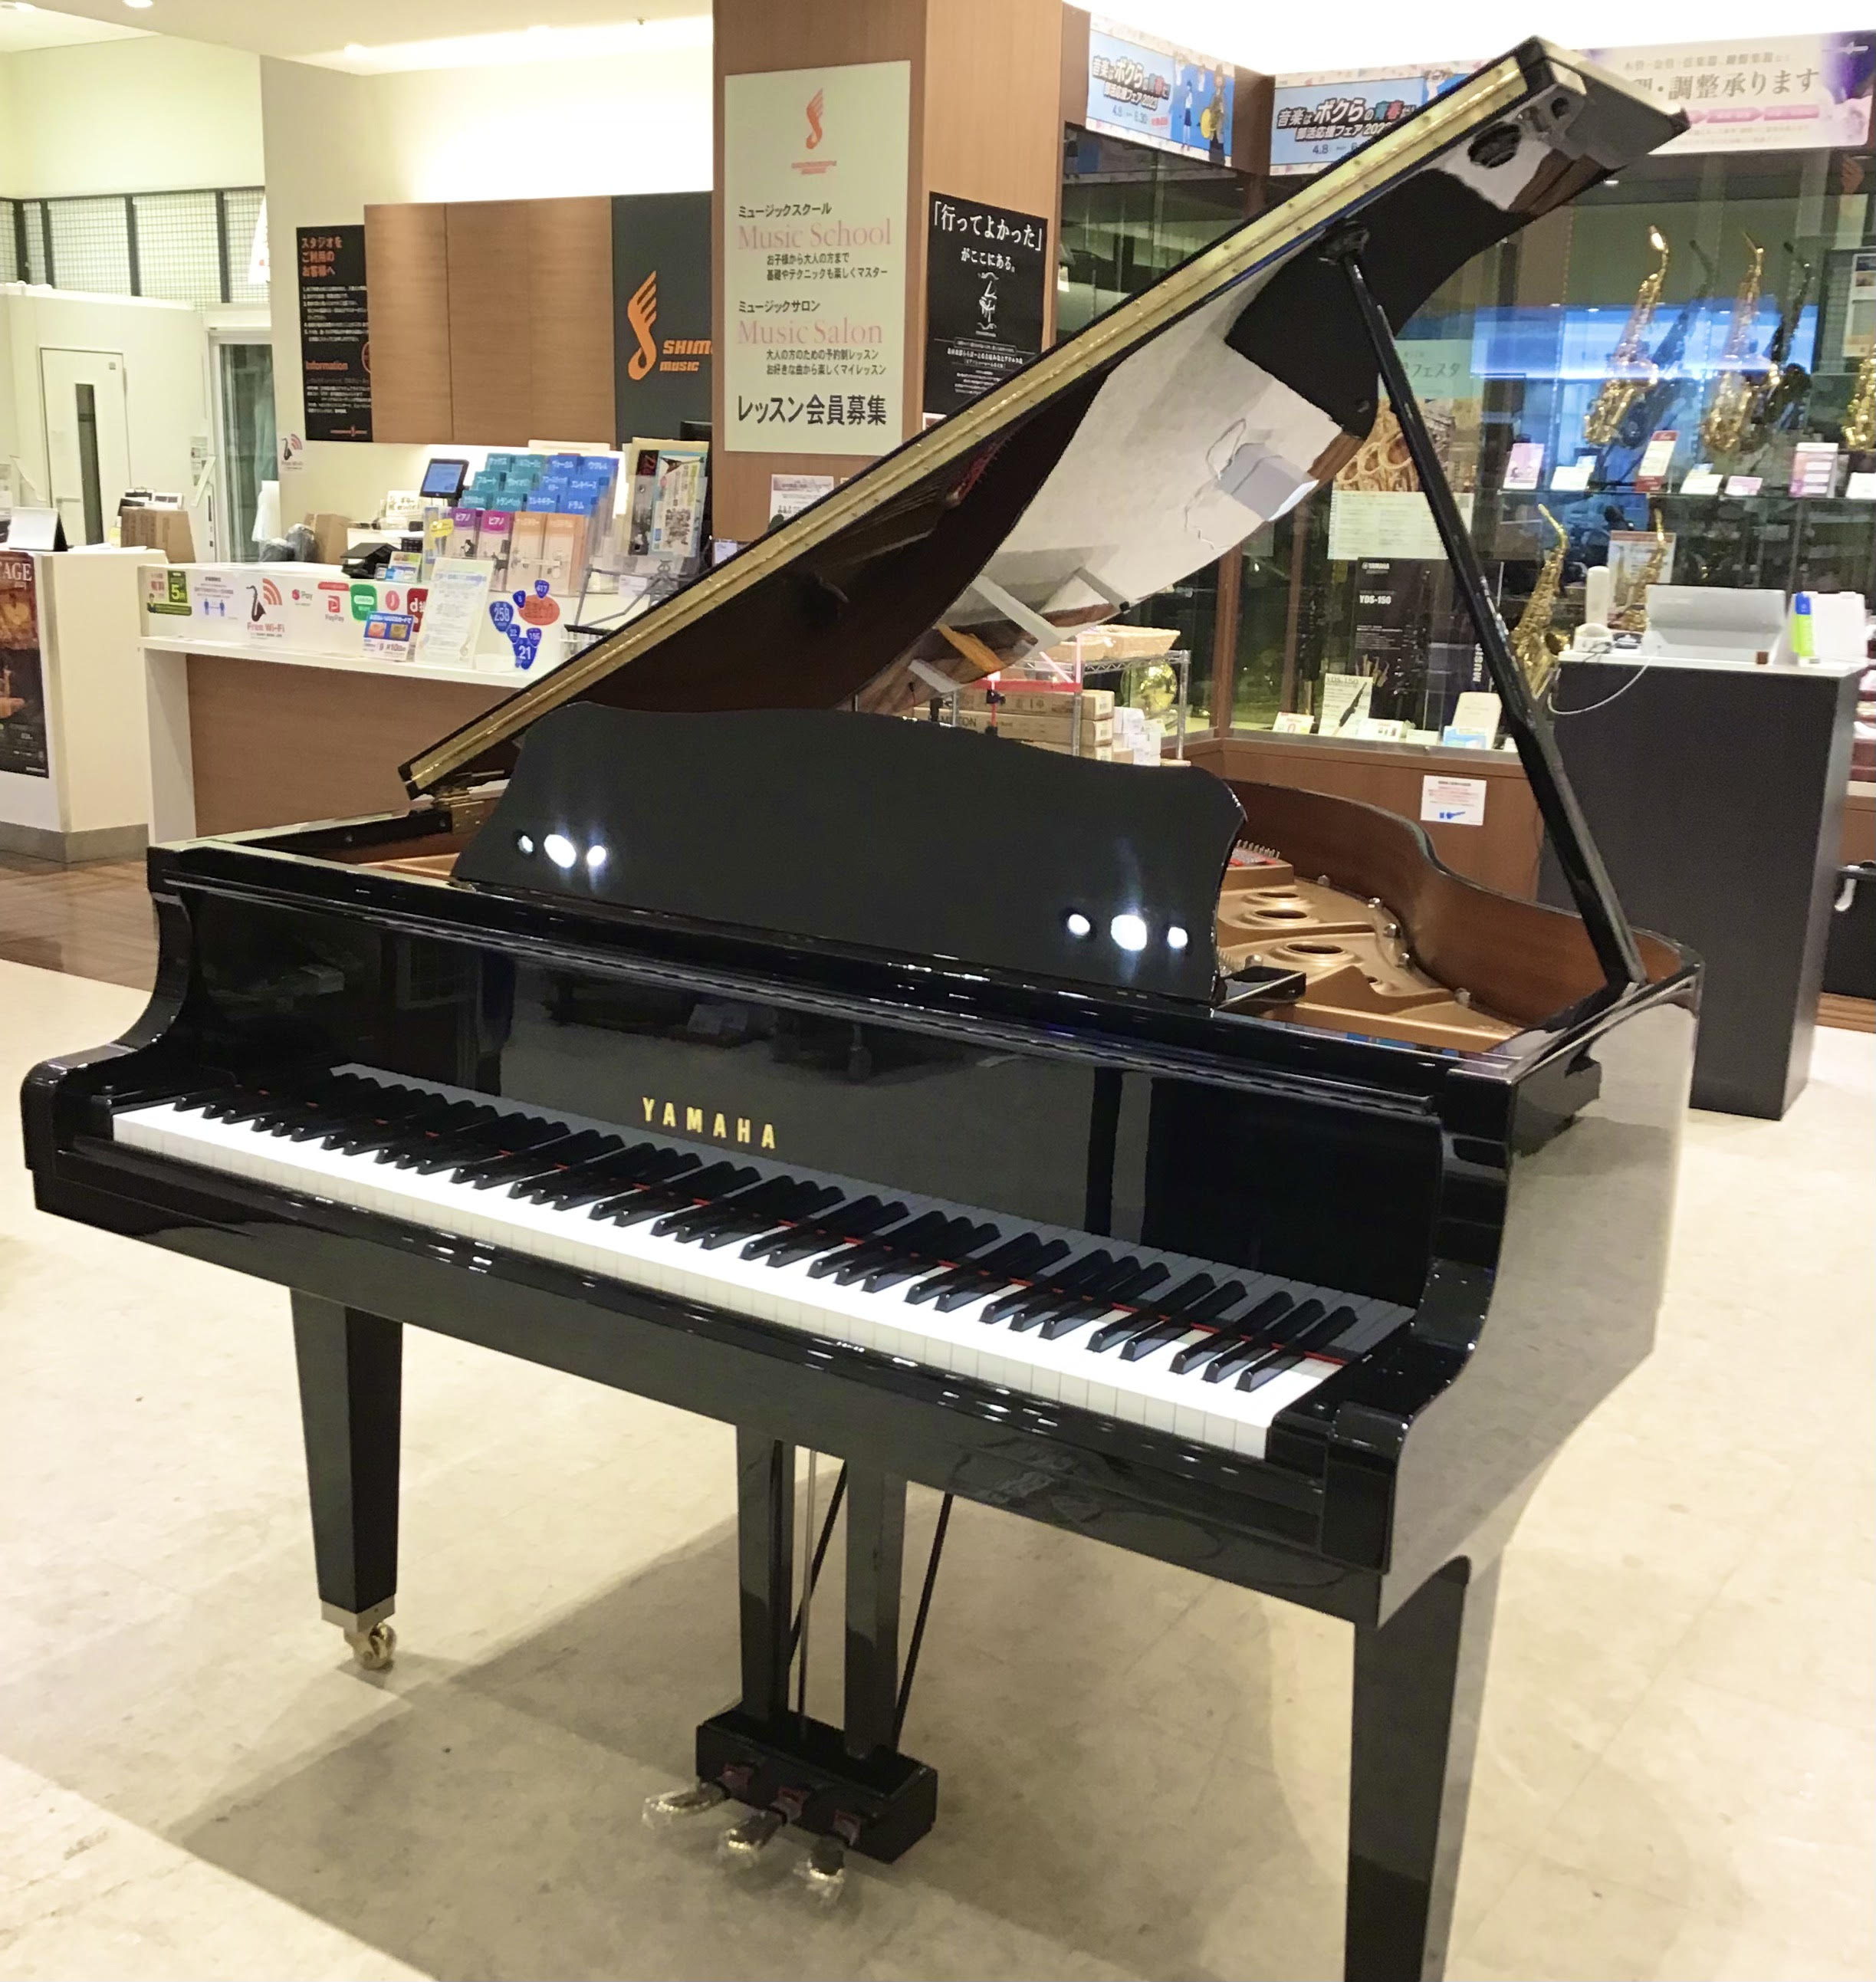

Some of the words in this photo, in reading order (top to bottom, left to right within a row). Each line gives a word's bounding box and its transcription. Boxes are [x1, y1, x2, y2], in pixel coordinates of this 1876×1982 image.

[738, 202, 833, 219] ミュージックスクール
[935, 201, 1043, 251] 「行ってよかった」
[738, 224, 804, 251] Music
[809, 218, 892, 248] School
[767, 252, 850, 266] お子様から大人の方まで
[961, 247, 1016, 273] がここにある。
[767, 267, 888, 281] 基礎やテクニックも楽しくマスター
[738, 300, 820, 313] ミュージックサロン
[738, 319, 809, 344] Music
[813, 317, 883, 345] Salon
[767, 363, 886, 376] お好きな曲から楽しくマイレッスン
[738, 393, 887, 426] レッスン会員募集
[455, 513, 471, 522] ピアノ
[488, 517, 505, 526] ピアノ
[0, 562, 32, 581] AGE
[494, 608, 510, 622] 258
[265, 623, 285, 633] Wi-Fi
[518, 646, 531, 660] 21
[642, 1096, 776, 1149] YAMAHA
